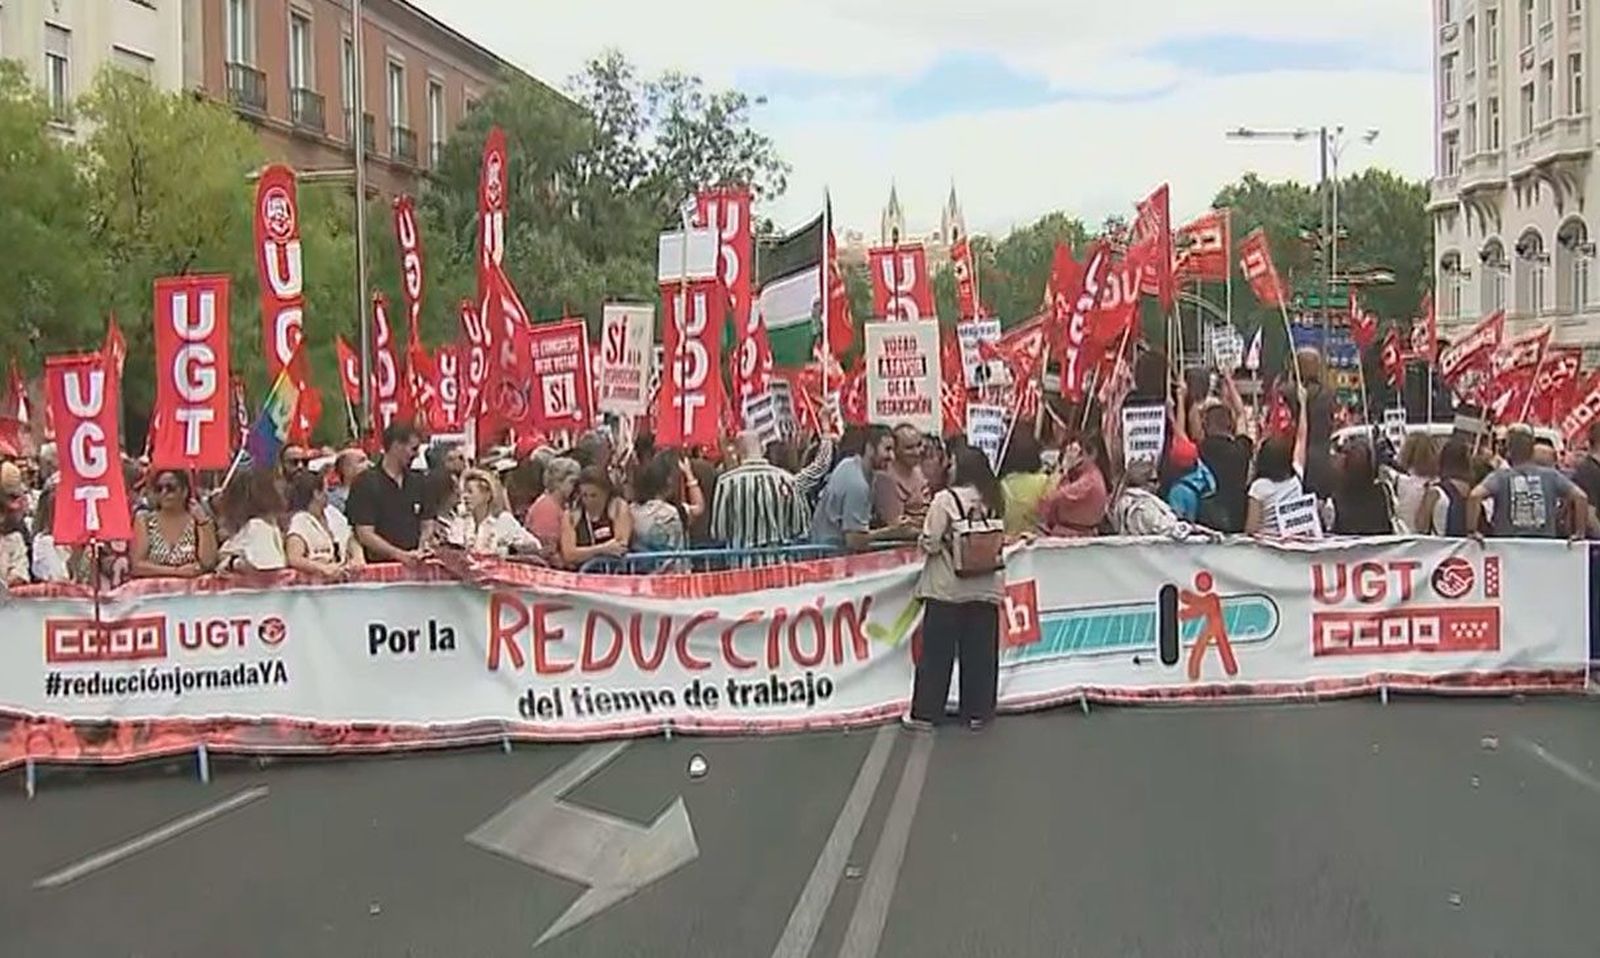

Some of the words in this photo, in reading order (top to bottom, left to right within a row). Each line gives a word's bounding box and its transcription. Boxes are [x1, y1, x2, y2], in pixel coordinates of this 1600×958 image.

[172, 292, 217, 456] UGT
[440, 353, 458, 424] UGT
[64, 370, 109, 531] UGT
[1313, 561, 1421, 604] UGT
[178, 619, 252, 649] UGT
[368, 623, 420, 654] Por
[429, 619, 456, 650] la
[488, 592, 871, 675] REDUCCIÓN
[1322, 616, 1440, 649] CCOO
[46, 660, 287, 696] #reducciónjornadaYA
[519, 686, 563, 718] del
[571, 686, 676, 713] tiempo
[684, 678, 719, 707] de
[727, 671, 833, 707] trabajo
